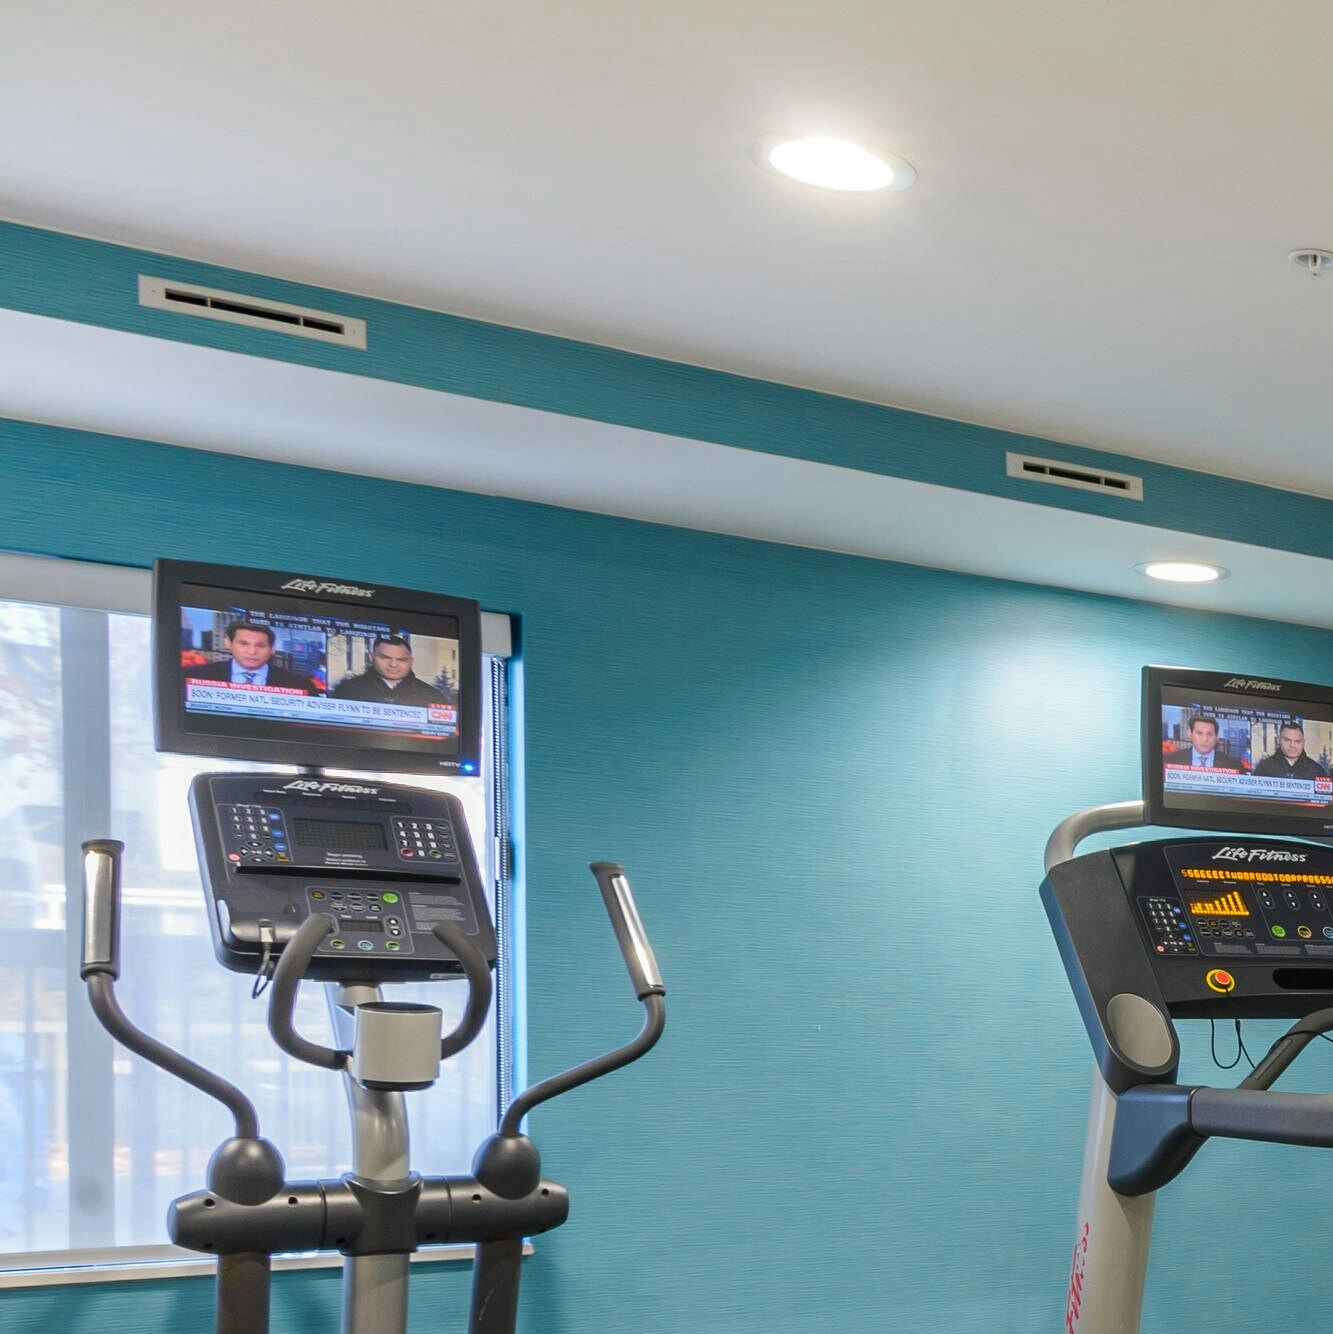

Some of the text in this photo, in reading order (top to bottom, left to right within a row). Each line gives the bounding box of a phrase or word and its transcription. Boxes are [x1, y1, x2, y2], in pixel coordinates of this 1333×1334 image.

[281, 579, 373, 598] Life Fitness
[283, 780, 378, 795] Life Fitness
[1212, 847, 1307, 862] Life Fitness
